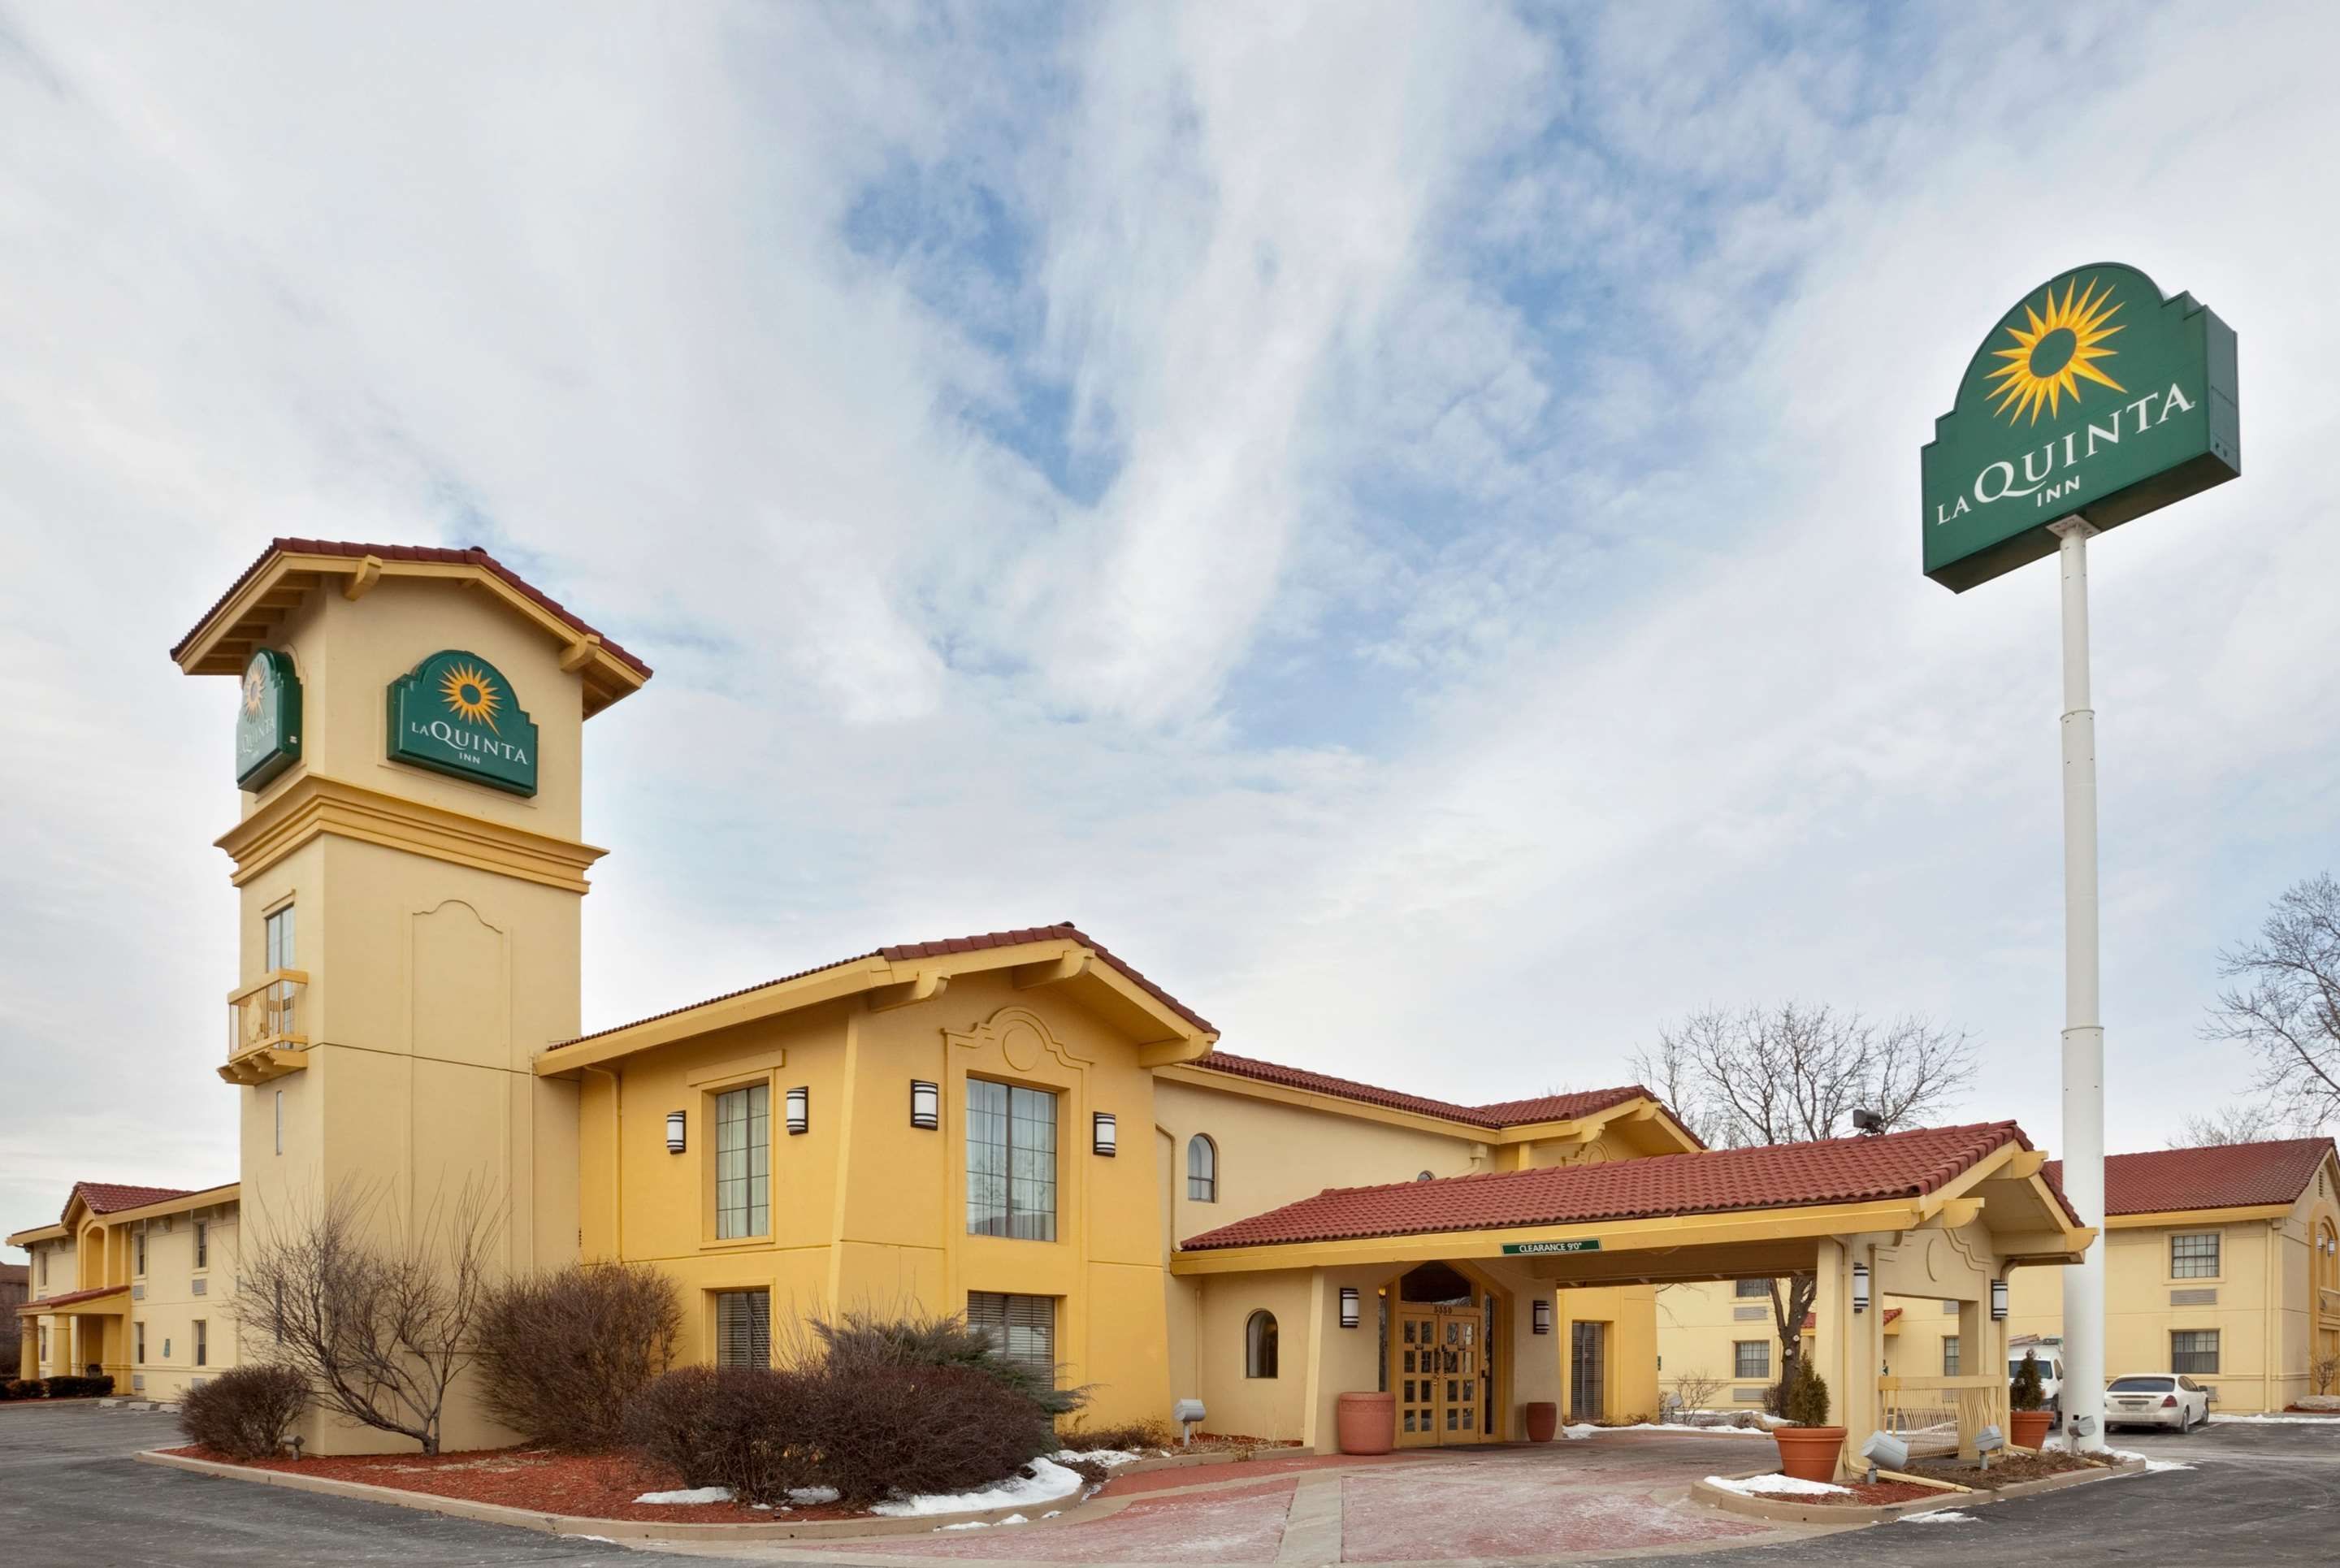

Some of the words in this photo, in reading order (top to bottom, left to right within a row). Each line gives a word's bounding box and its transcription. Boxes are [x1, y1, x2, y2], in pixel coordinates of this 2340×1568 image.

[1937, 495, 1971, 525] LA
[1974, 383, 2195, 504] QUINTA
[2036, 475, 2080, 508] INN
[411, 721, 430, 737] LA
[431, 721, 528, 765] QUINTA
[459, 752, 481, 765] INN
[1519, 1244, 1566, 1253] CLEARANCE
